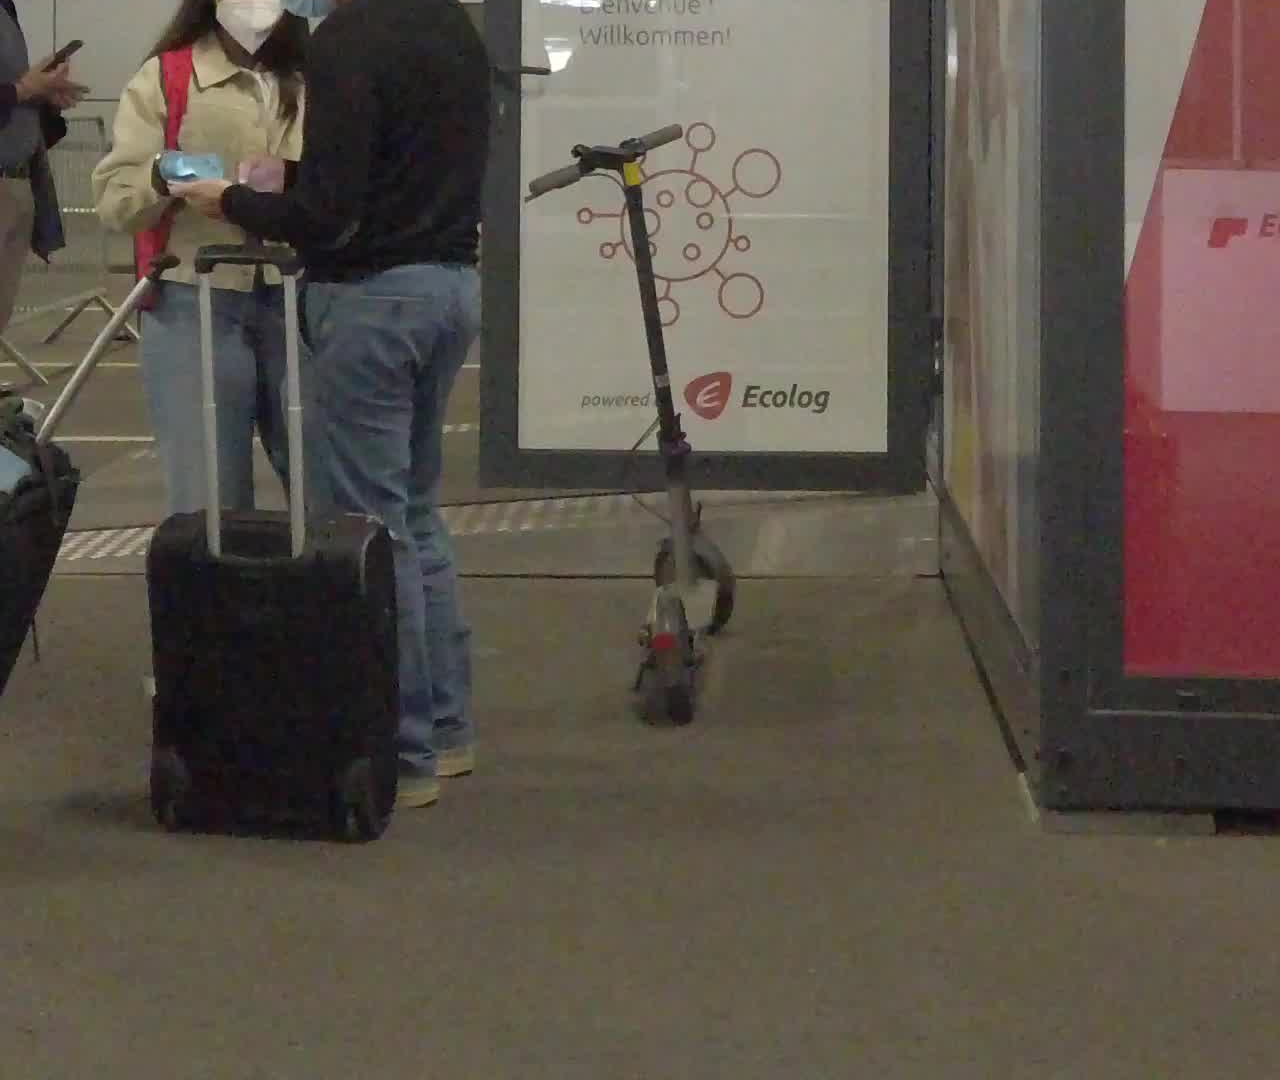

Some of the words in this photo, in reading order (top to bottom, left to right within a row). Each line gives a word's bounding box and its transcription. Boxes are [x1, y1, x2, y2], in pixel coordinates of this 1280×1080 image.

[578, 23, 732, 47] Willkommen!
[580, 391, 651, 409] powered
[742, 384, 831, 414] Ecolog
